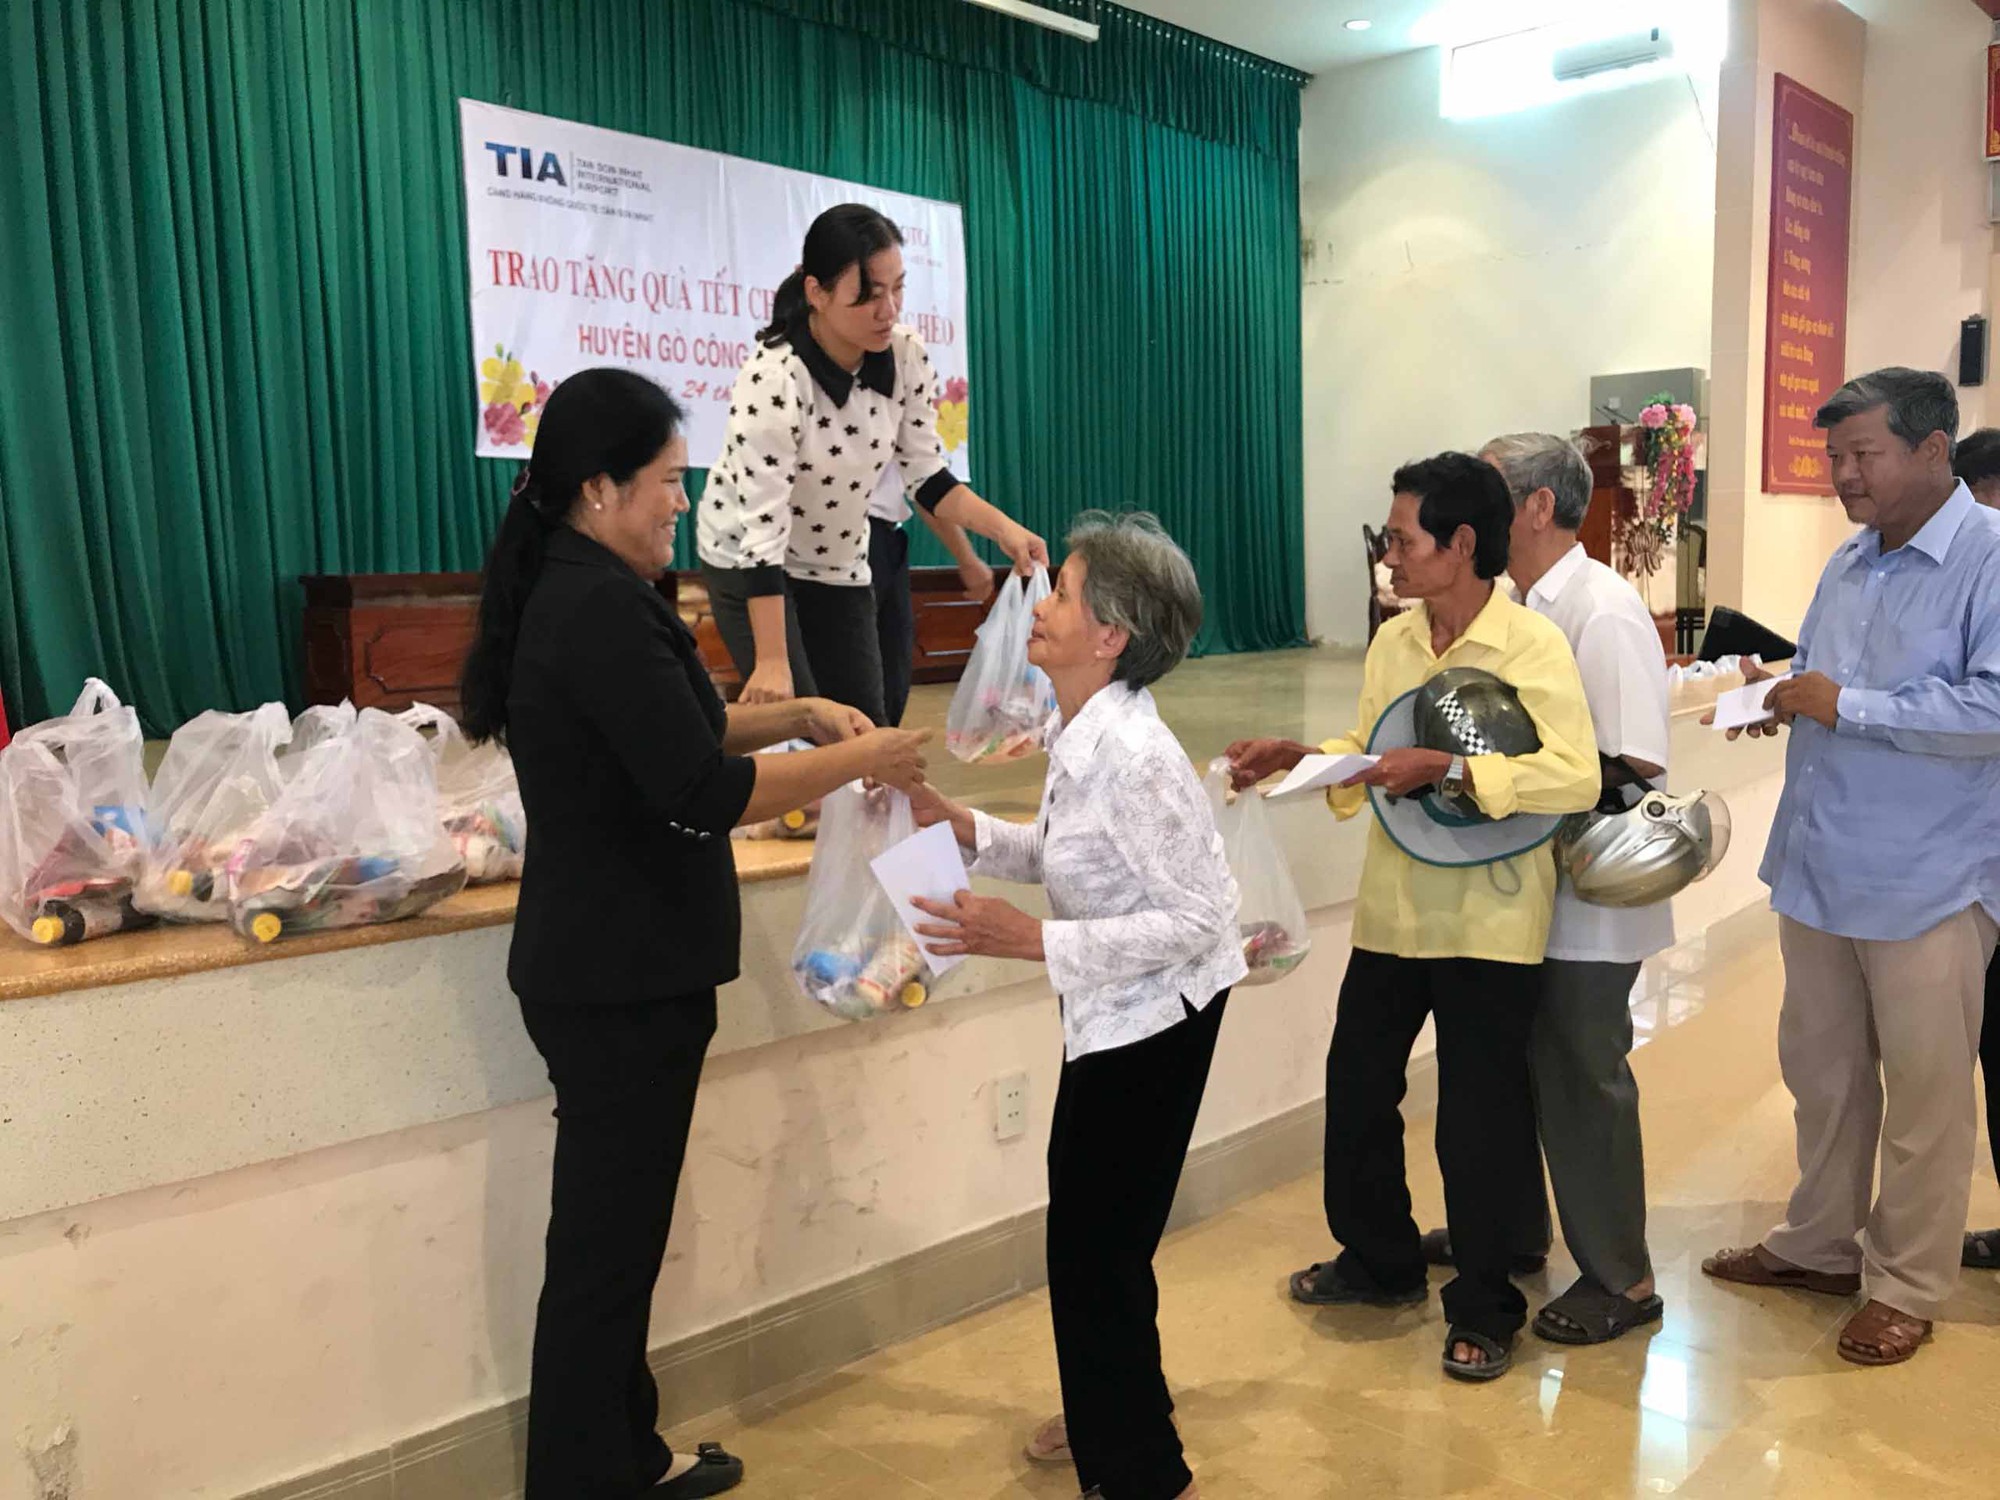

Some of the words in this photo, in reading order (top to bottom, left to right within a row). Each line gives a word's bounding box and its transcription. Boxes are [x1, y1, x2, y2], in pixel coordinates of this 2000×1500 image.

[484, 142, 568, 187] TIA
[488, 249, 560, 293] TRAO
[566, 255, 635, 304] TẶNG
[642, 265, 692, 315] QUÀ
[698, 265, 743, 317] TẾT
[578, 321, 650, 365] HUYỆN
[657, 328, 688, 364] GÒ
[693, 332, 749, 369] CÔNG
